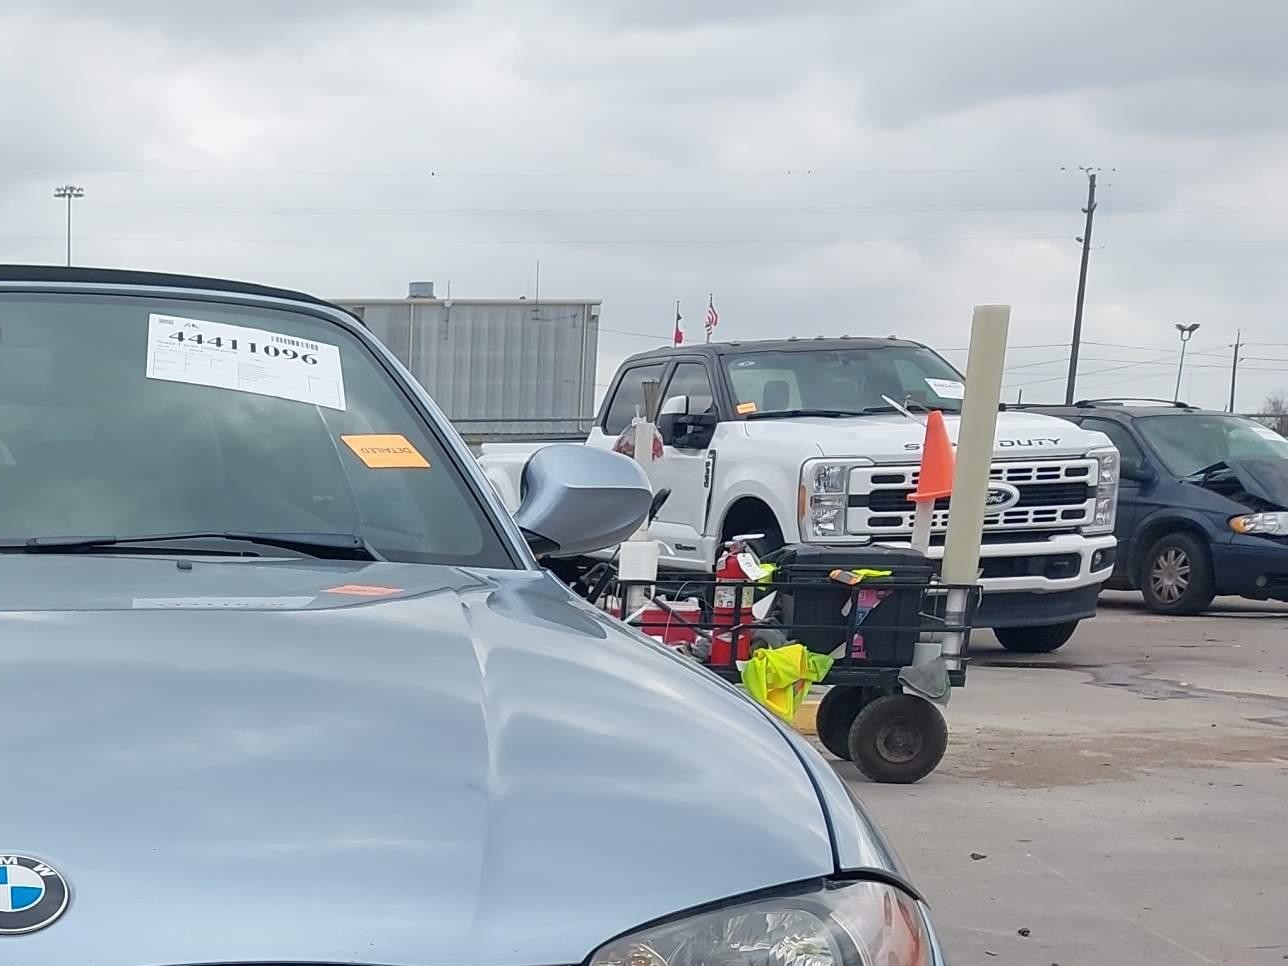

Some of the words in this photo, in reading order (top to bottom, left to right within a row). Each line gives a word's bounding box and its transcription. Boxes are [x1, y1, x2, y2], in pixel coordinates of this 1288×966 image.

[169, 331, 319, 365] 44411096
[999, 438, 1061, 447] DUTY
[986, 490, 1006, 504] ord
